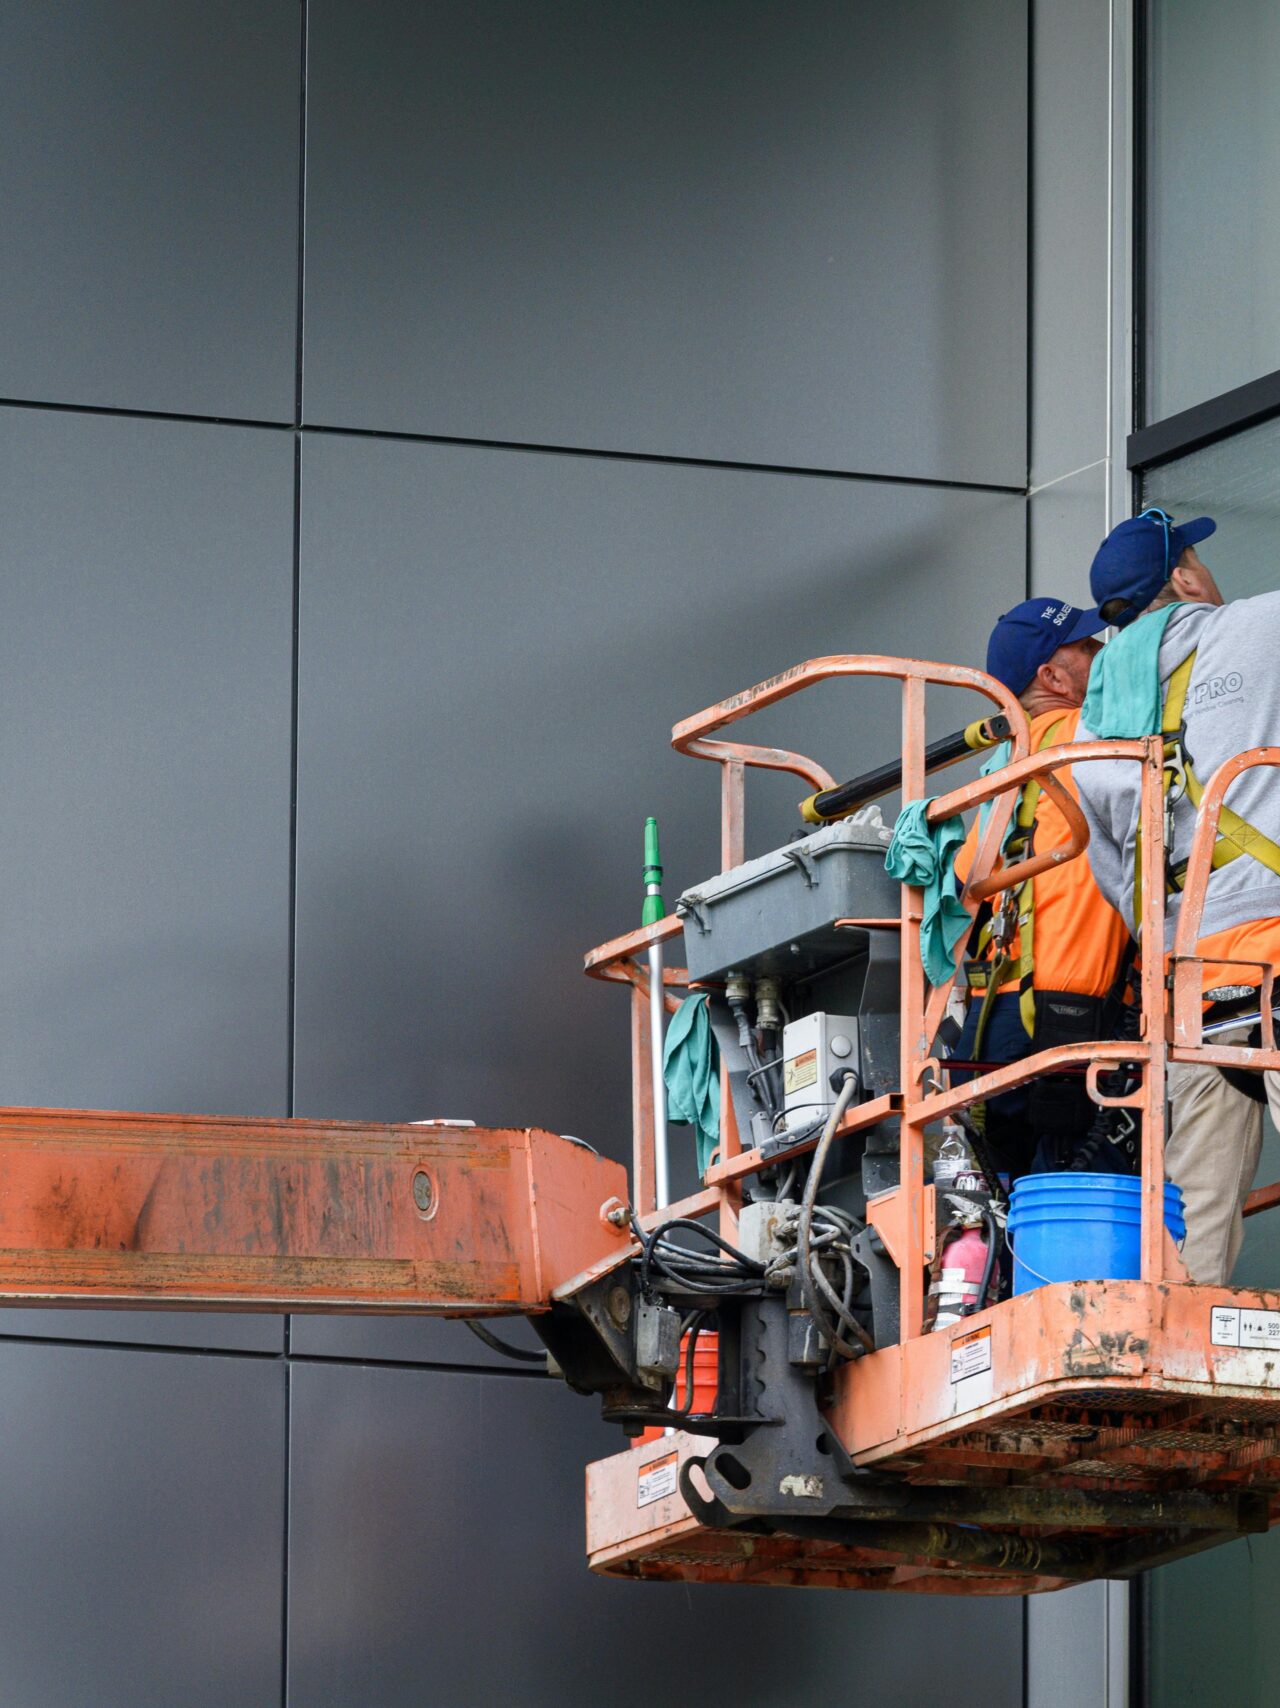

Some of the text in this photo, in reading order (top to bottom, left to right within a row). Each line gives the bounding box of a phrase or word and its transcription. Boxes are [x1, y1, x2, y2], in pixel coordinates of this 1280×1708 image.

[1040, 606, 1056, 619] THE
[1195, 671, 1243, 704] PRO
[1267, 1322, 1280, 1330] 500
